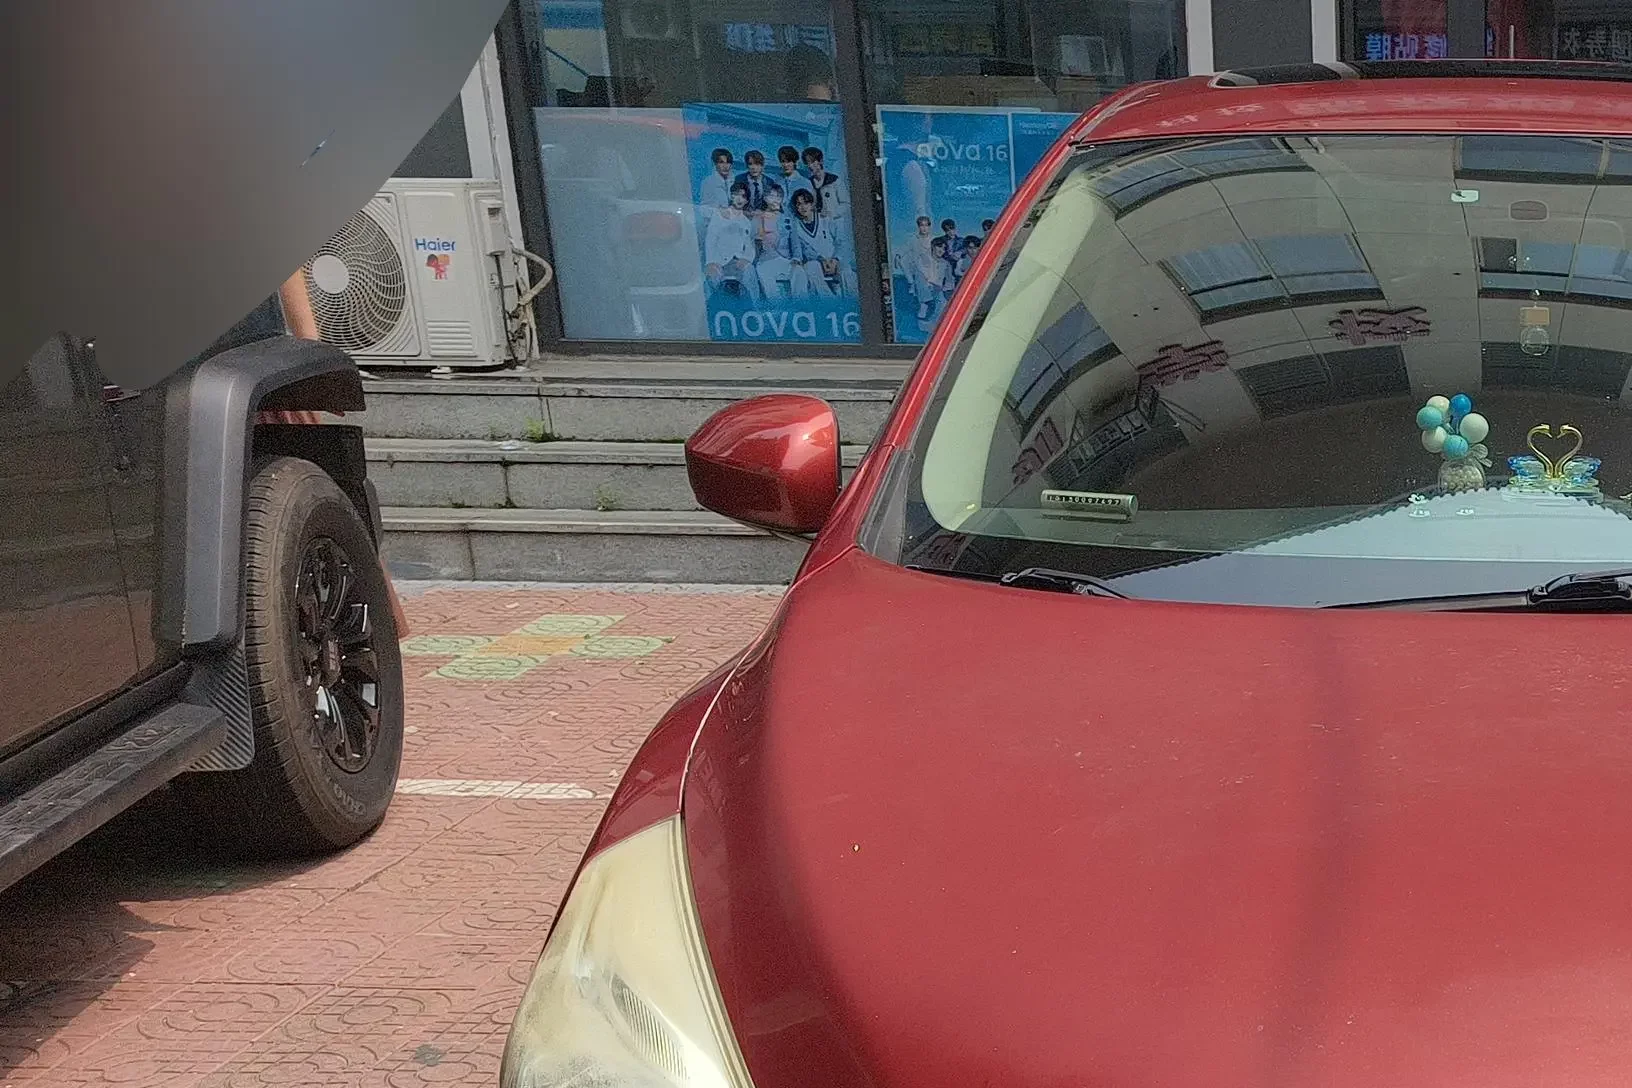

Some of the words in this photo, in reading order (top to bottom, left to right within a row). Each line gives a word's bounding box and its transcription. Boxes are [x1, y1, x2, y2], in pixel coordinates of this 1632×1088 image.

[917, 141, 980, 160] nova
[986, 144, 1009, 161] 16
[415, 237, 456, 251] Haier
[714, 311, 817, 338] nova
[826, 311, 861, 338] 16
